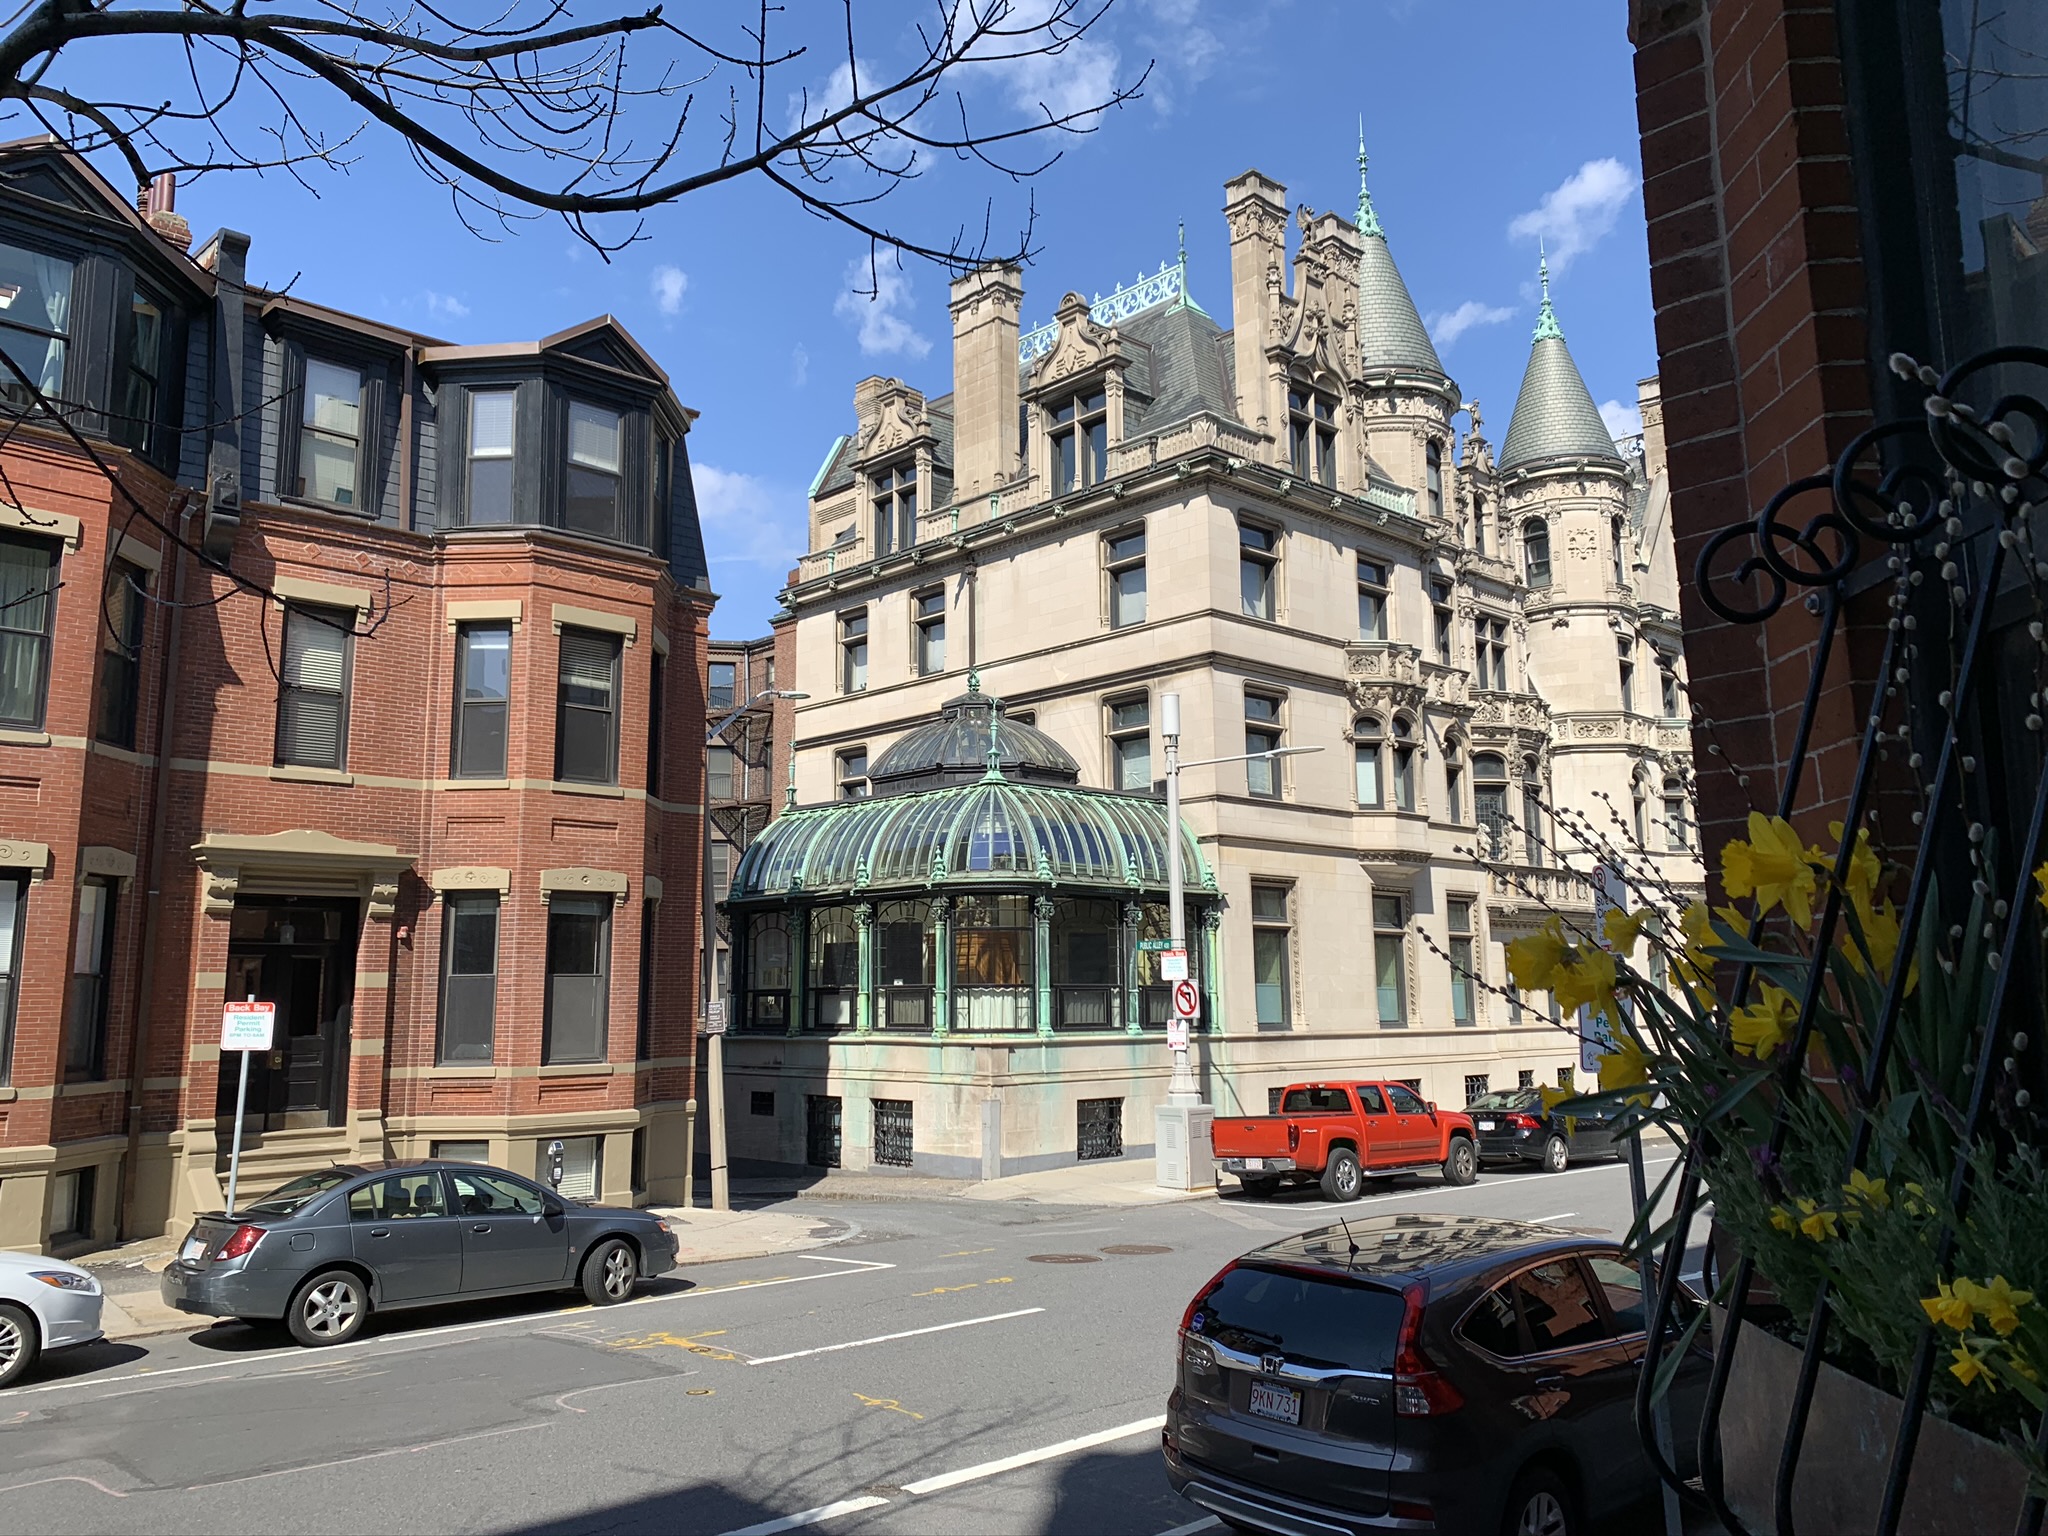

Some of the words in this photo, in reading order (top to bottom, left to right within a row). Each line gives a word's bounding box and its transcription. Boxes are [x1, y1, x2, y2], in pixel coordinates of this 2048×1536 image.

[1139, 941, 1152, 949] PUBLIC
[1152, 941, 1163, 949] ALLEY
[253, 1004, 270, 1012] Bay
[1251, 1388, 1273, 1410] 9KN
[1276, 1394, 1297, 1416] 731
